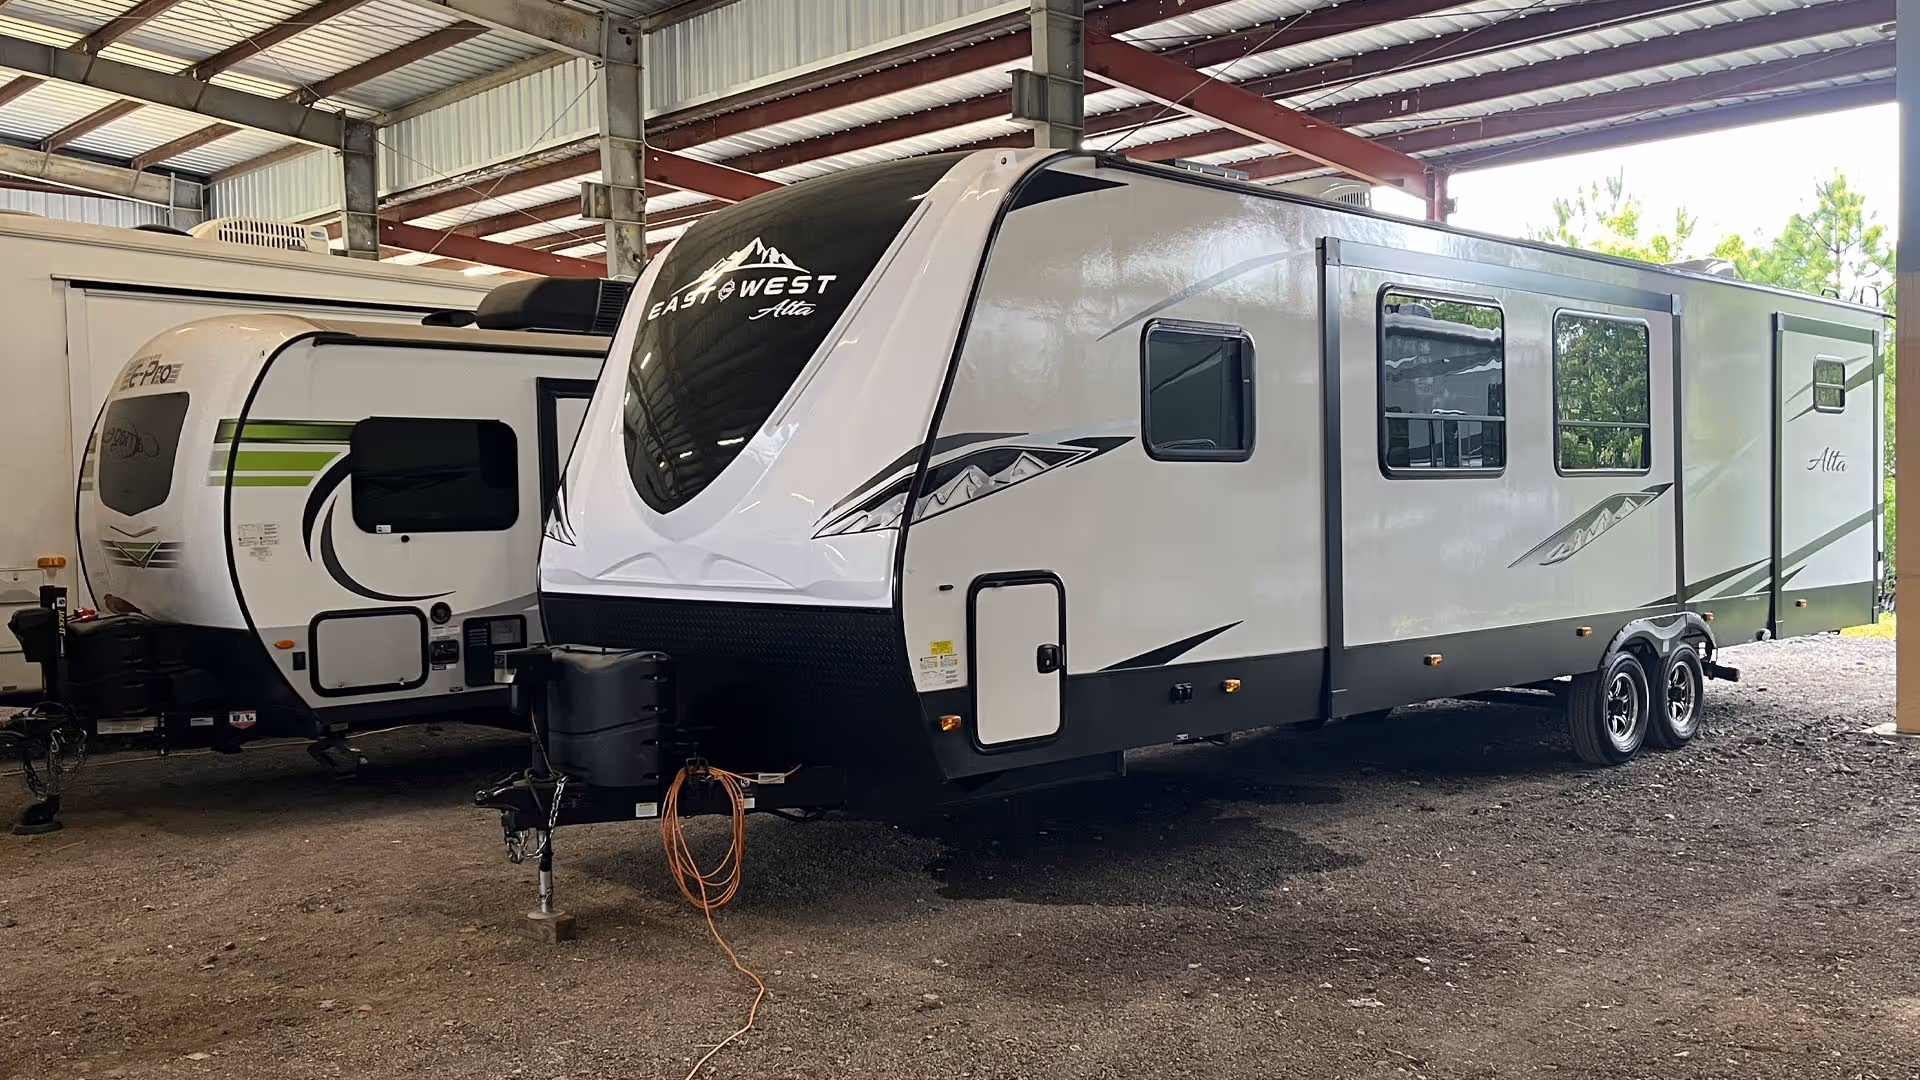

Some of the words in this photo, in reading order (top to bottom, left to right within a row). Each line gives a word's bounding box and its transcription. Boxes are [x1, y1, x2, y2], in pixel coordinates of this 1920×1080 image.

[647, 285, 717, 321] EAST
[739, 275, 837, 298] WEST
[748, 299, 817, 320] Alta
[1807, 447, 1848, 472] Alta
